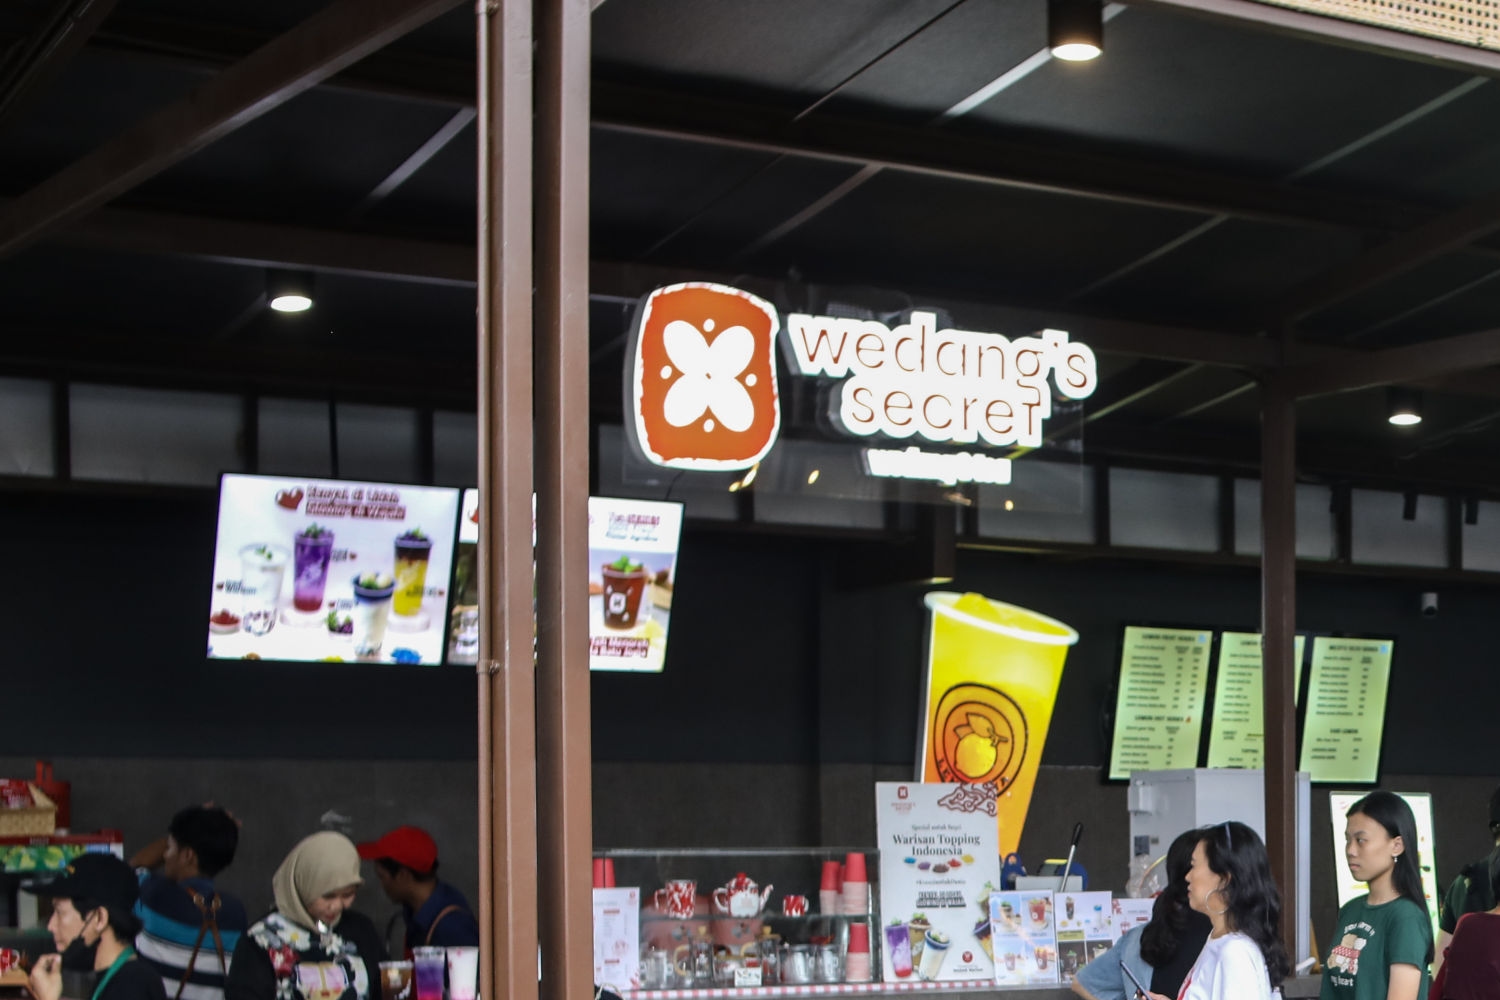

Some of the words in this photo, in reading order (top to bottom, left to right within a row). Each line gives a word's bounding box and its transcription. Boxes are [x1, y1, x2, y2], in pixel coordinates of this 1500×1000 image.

[800, 325, 1089, 391] wedang's
[850, 386, 1043, 437] secret
[912, 845, 963, 856] Indonesia
[936, 834, 981, 846] Topping
